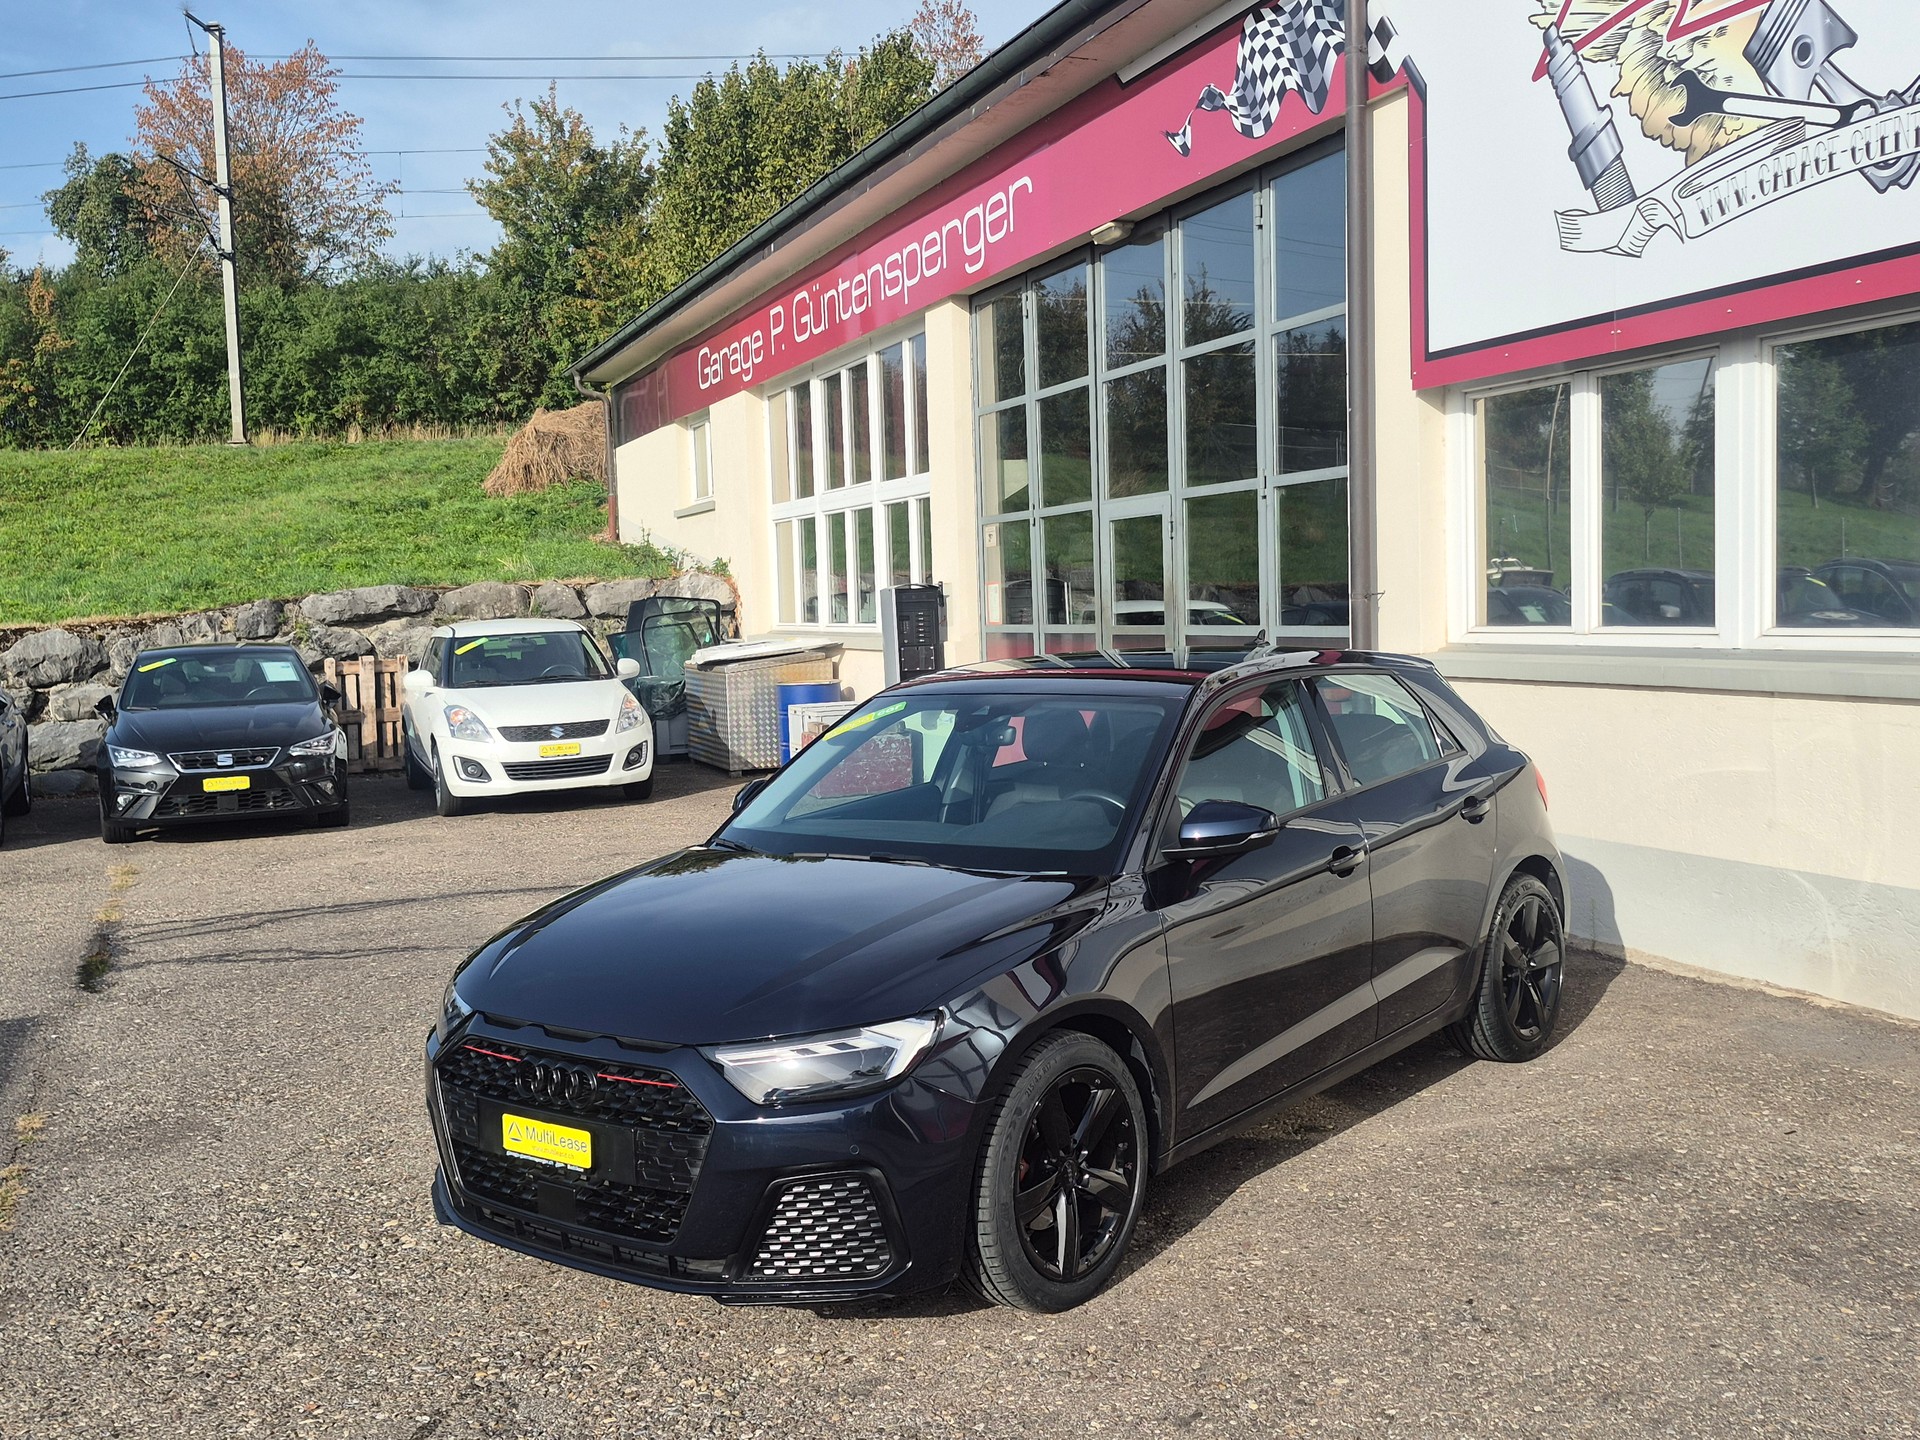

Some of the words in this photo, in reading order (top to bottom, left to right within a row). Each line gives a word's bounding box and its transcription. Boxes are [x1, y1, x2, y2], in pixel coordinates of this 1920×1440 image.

[697, 328, 763, 390] Garage
[769, 305, 785, 355] P.
[792, 175, 1034, 343] Güntensperger
[525, 1125, 588, 1153] MultiLease
